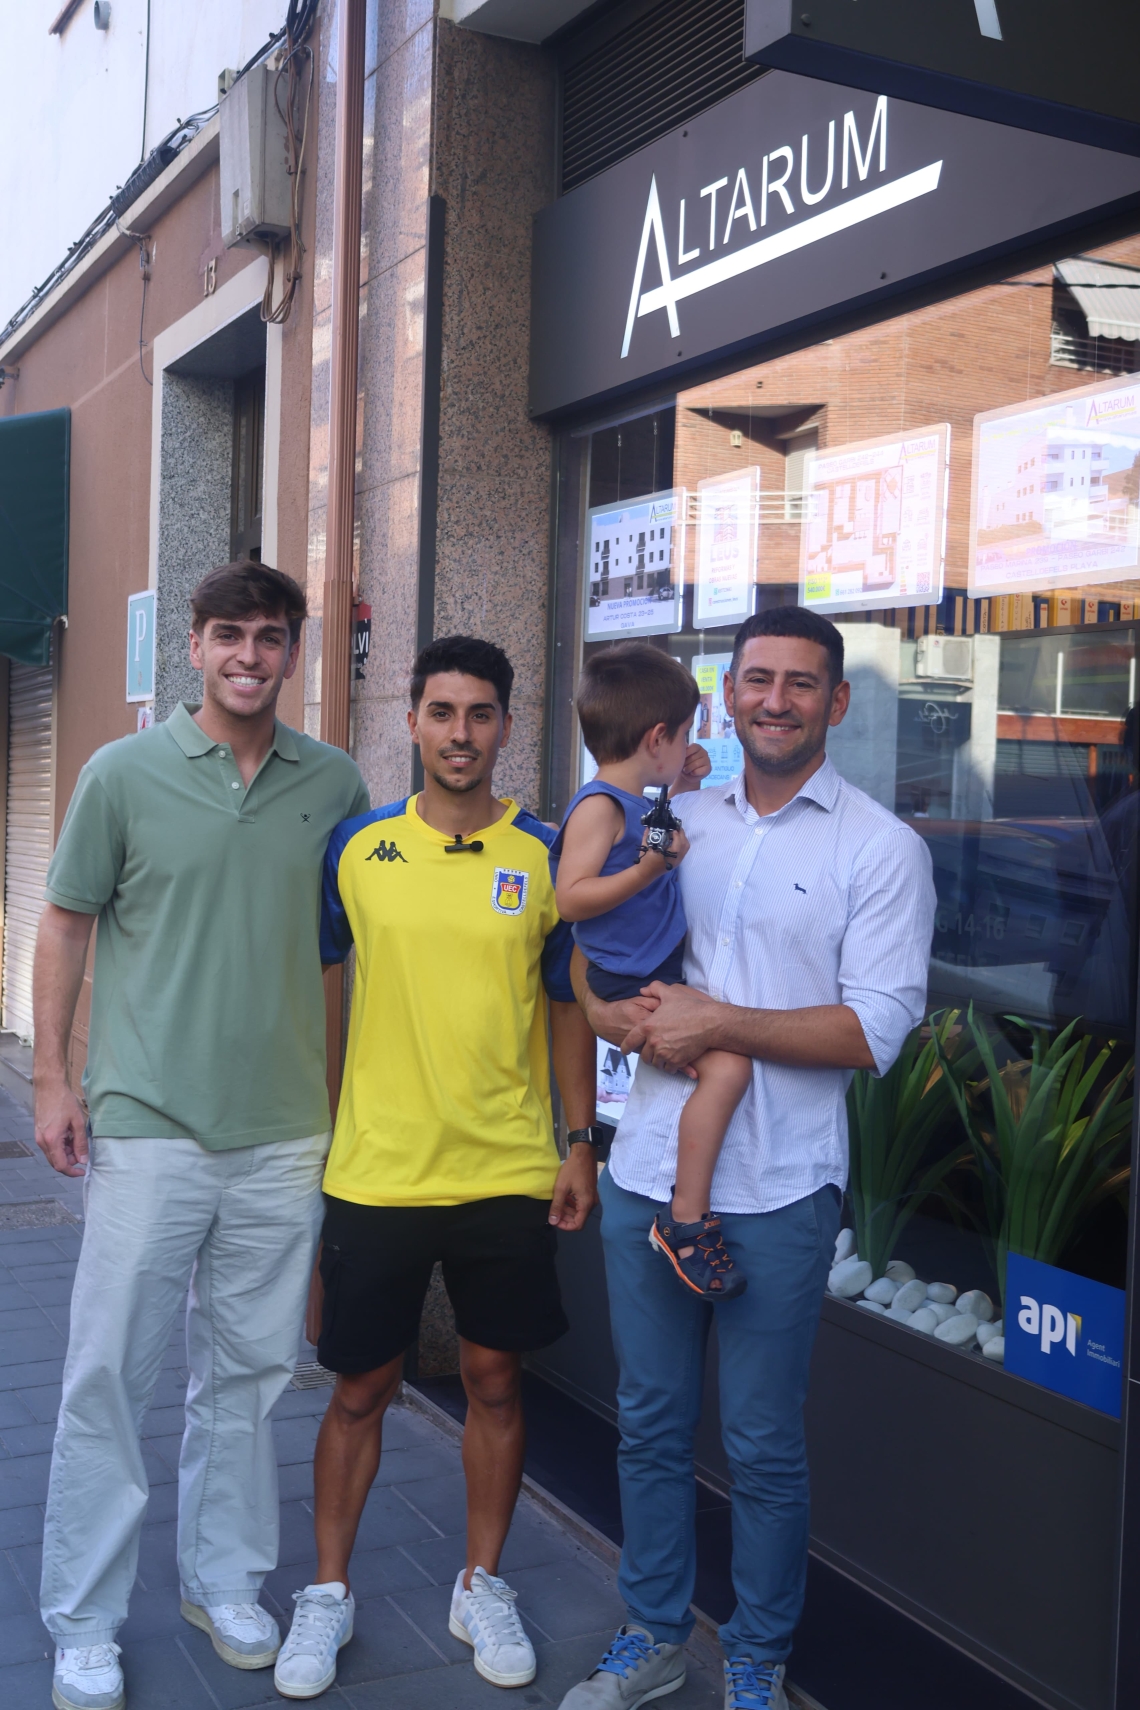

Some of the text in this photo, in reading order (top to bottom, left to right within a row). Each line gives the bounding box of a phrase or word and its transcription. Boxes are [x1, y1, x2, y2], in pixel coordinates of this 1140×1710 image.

[620, 95, 888, 358] ALTARUM
[204, 257, 218, 298] 13
[1086, 395, 1135, 427] ALTARUM
[898, 439, 936, 465] ALTARUM
[710, 542, 740, 563] LEUS
[1058, 552, 1084, 561] PASEO
[1006, 560, 1098, 579] CASTELLDEFELS PLAYA
[607, 601, 622, 610] NUEVA
[603, 613, 619, 621] ARTUR
[620, 612, 637, 620] COSTA
[134, 610, 147, 662] P
[503, 884, 518, 892] UEC
[1018, 1295, 1082, 1357] api
[1087, 1339, 1106, 1352] Agent
[1087, 1348, 1121, 1368] Immobiliari
